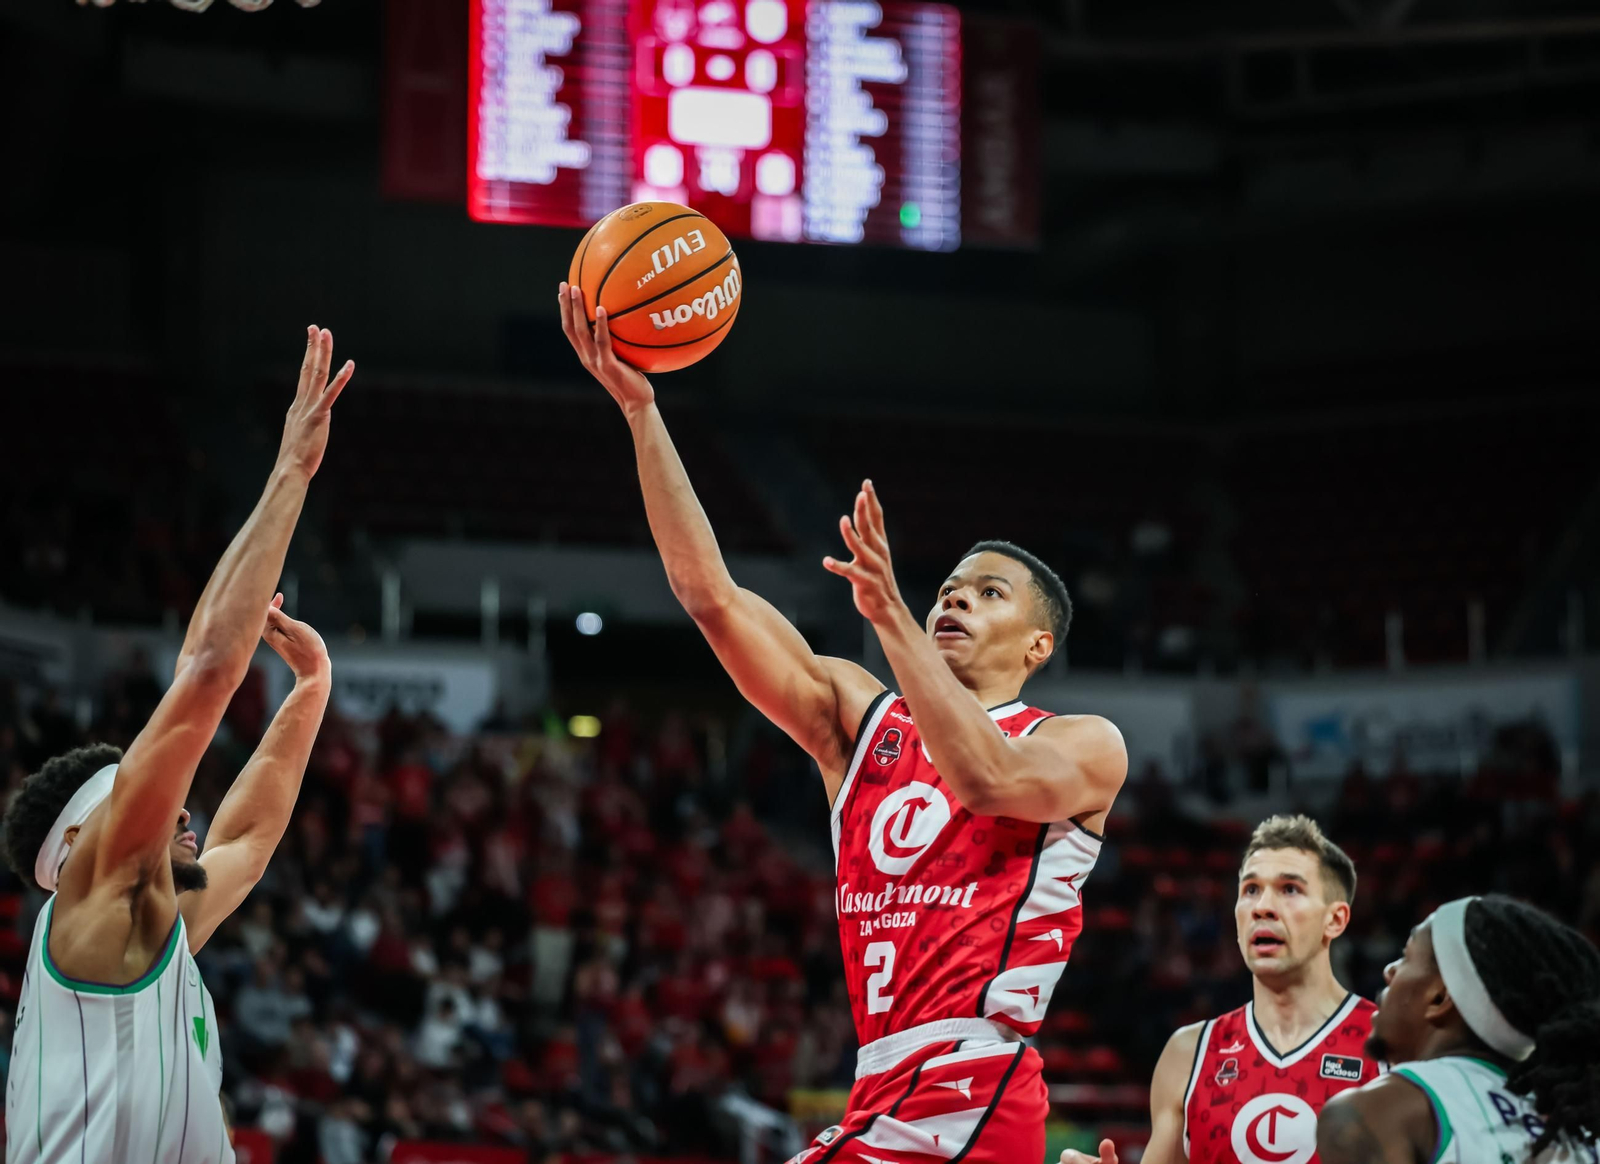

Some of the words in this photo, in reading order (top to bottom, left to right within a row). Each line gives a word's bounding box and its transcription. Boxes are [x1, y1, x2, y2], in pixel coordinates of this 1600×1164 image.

[636, 272, 656, 290] NXT
[649, 268, 741, 331] Wilson
[840, 881, 980, 913] Casadmont
[864, 940, 897, 1016] 2
[1325, 1060, 1342, 1070] liga
